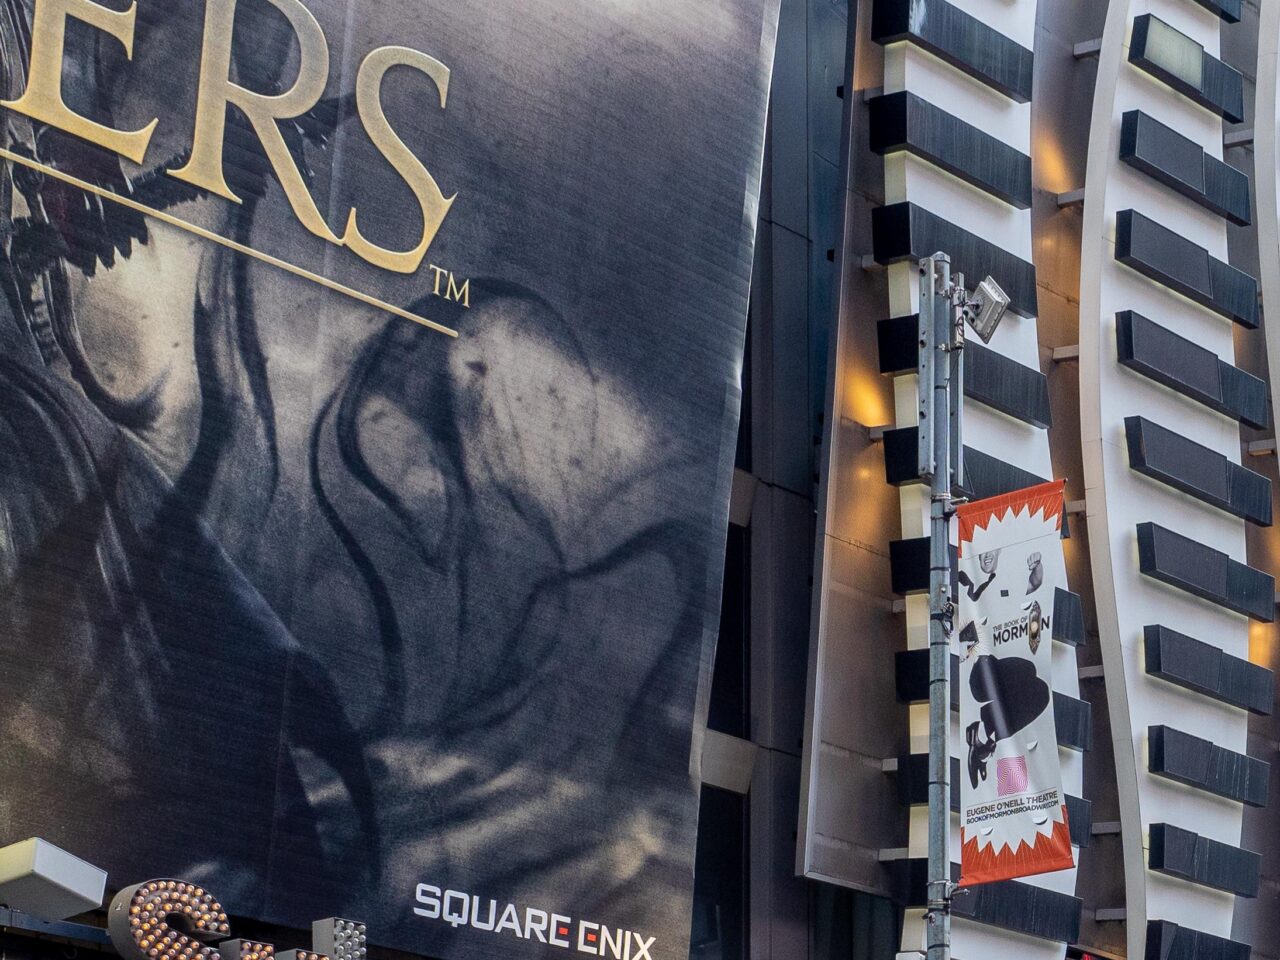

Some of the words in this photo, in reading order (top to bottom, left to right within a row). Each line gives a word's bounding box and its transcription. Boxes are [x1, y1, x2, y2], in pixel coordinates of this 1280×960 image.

[1004, 618, 1019, 629] BOOK
[967, 805, 995, 817] EUGENE
[997, 798, 1025, 811] O'NEILL
[1026, 791, 1058, 804] THEATRE
[413, 883, 571, 947] SQUARE
